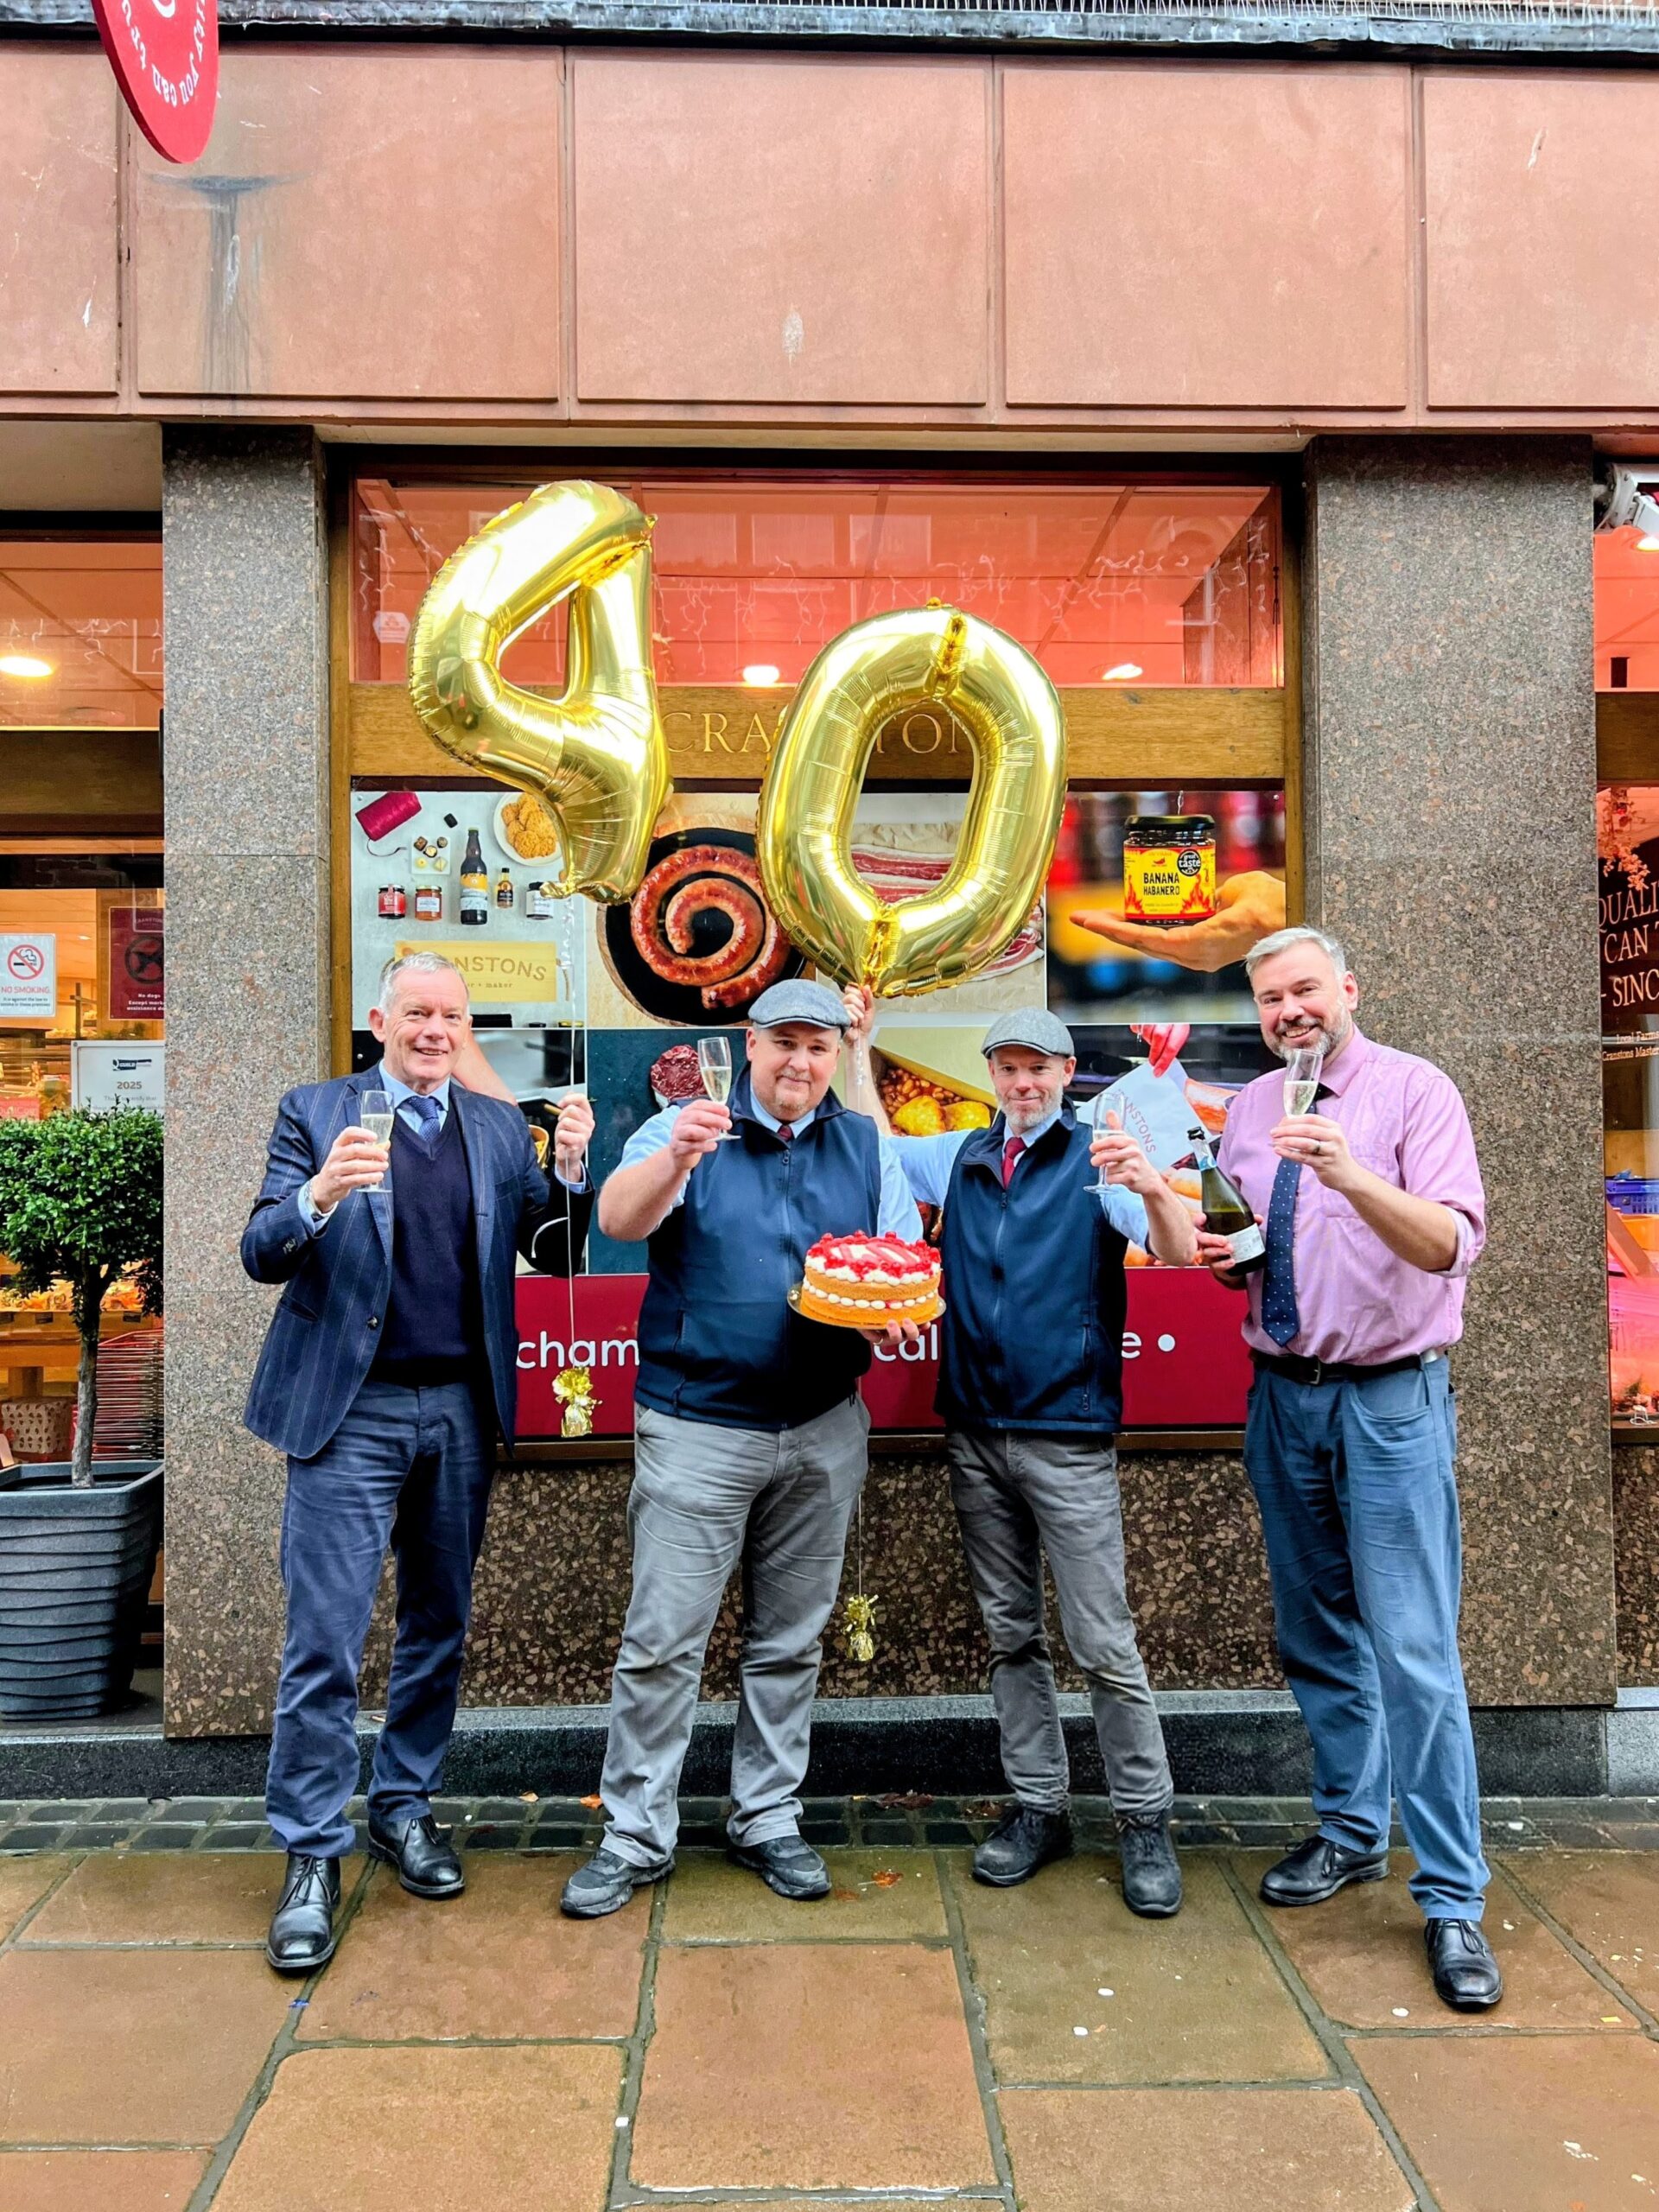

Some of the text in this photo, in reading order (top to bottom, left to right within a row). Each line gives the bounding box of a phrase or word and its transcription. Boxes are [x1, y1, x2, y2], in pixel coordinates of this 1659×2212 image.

[179, 52, 200, 105] you
[152, 63, 177, 108] can
[1143, 873, 1180, 883] BANANA
[1143, 886, 1180, 895] HABANERO
[1605, 924, 1649, 963] CAN
[1616, 1033, 1635, 1045] Local
[1602, 1049, 1633, 1062] Cranstons
[117, 1081, 143, 1090] 2025
